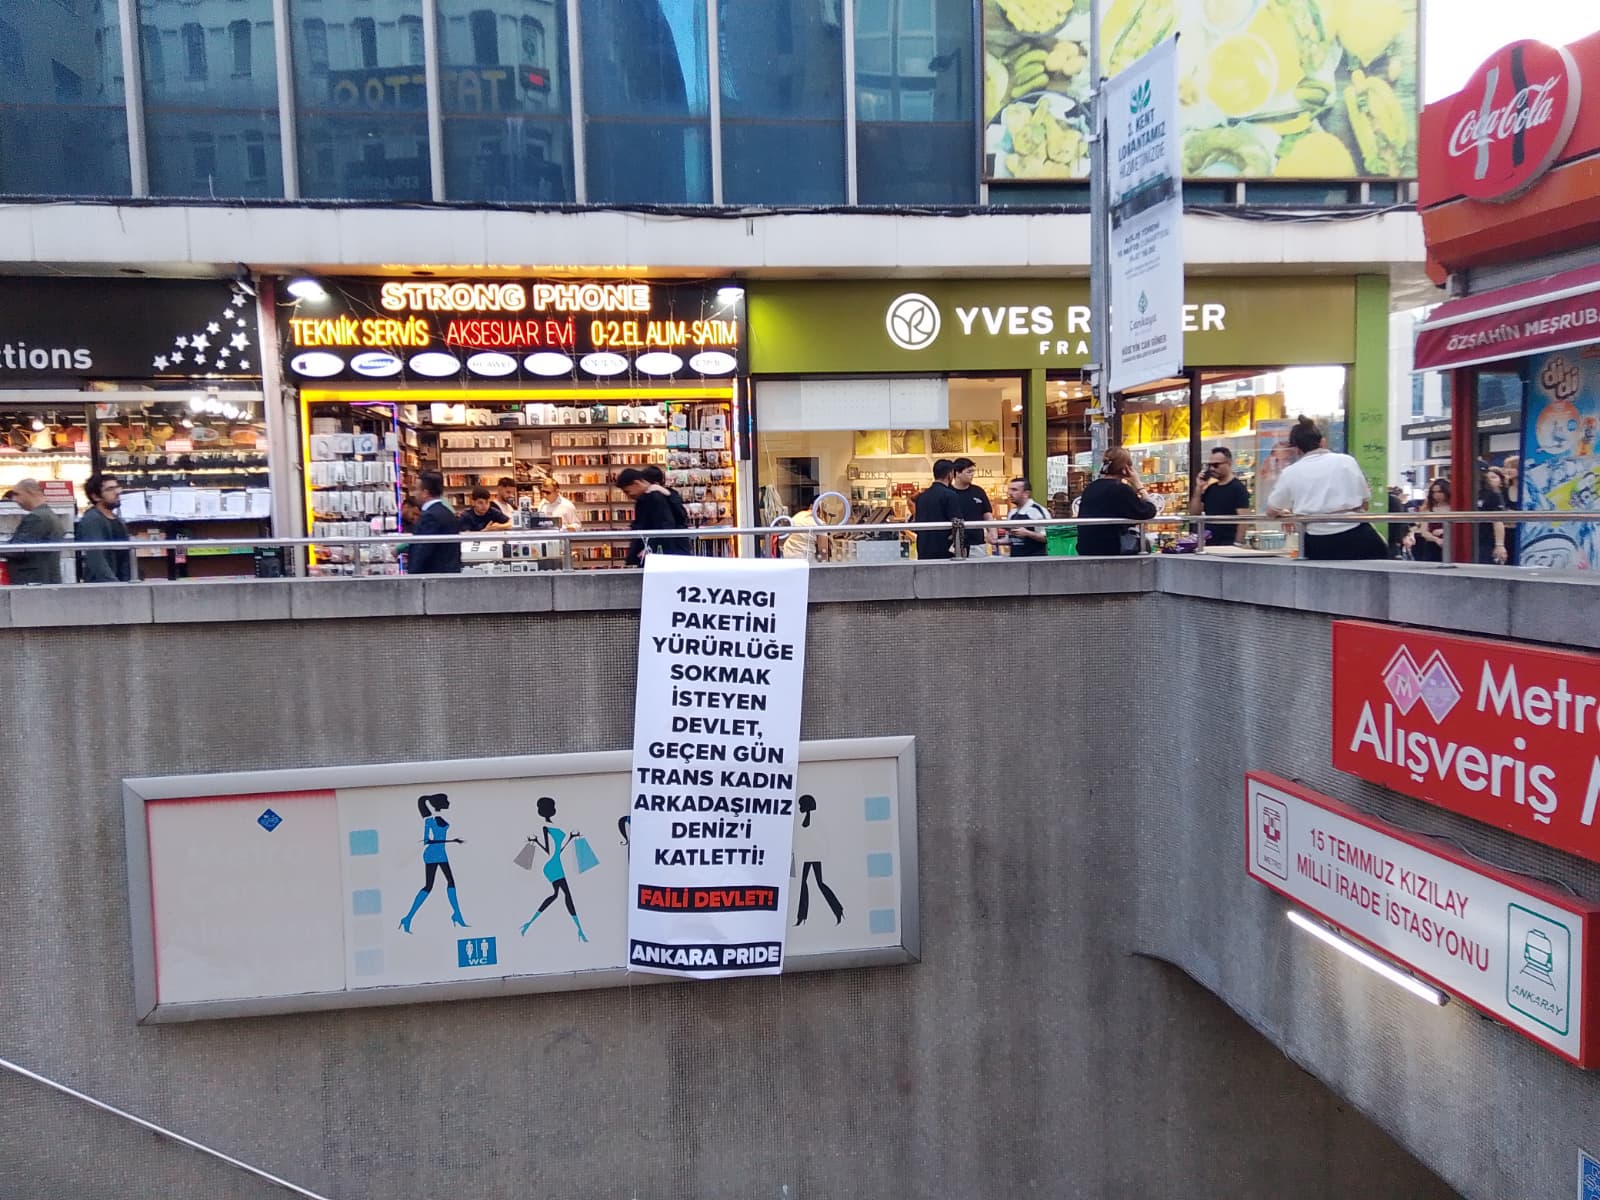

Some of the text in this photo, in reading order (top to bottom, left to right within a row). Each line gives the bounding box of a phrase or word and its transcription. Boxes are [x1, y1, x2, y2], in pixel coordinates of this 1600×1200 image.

[1136, 107, 1155, 132] KENT
[1448, 75, 1561, 157] Coca-Cola
[381, 282, 650, 311] STRONG PHONE
[289, 314, 430, 346] TEKNİK SERVİS
[446, 316, 575, 346] AKSESUAR EVİ
[955, 304, 1226, 335] YVES RER
[1524, 308, 1600, 337] MEŞRUB
[645, 320, 738, 346] ALIM-SATIM
[1040, 341, 1089, 355] FRA
[676, 586, 776, 608] 12.YARGI
[672, 611, 776, 633] PAKETİNİ
[652, 633, 794, 660] YÜRÜRLÜĞE
[670, 664, 771, 685] SOKMAK
[672, 685, 767, 710] İSTEYEN
[1477, 660, 1600, 734] Metr
[672, 716, 763, 739] DEVLET,
[649, 742, 784, 764] GEÇEN GÜN
[1350, 700, 1558, 824] Alışveriş
[637, 768, 793, 790] TRANS KADIN
[634, 794, 793, 817] ARKADAŞIMIZ
[671, 818, 752, 839] DENİZ'İ
[654, 845, 765, 865] KATLETTİ!
[1310, 827, 1469, 919] 15 TEMMUZ KIZILAY
[641, 887, 773, 908] FAİLİ DEVLET!
[1297, 852, 1489, 973] MİLLİ İRADE İSTASYONU
[468, 957, 488, 966] WC
[631, 944, 780, 966] ANKARA PRIDE
[1511, 985, 1563, 1016] ANKARAY
